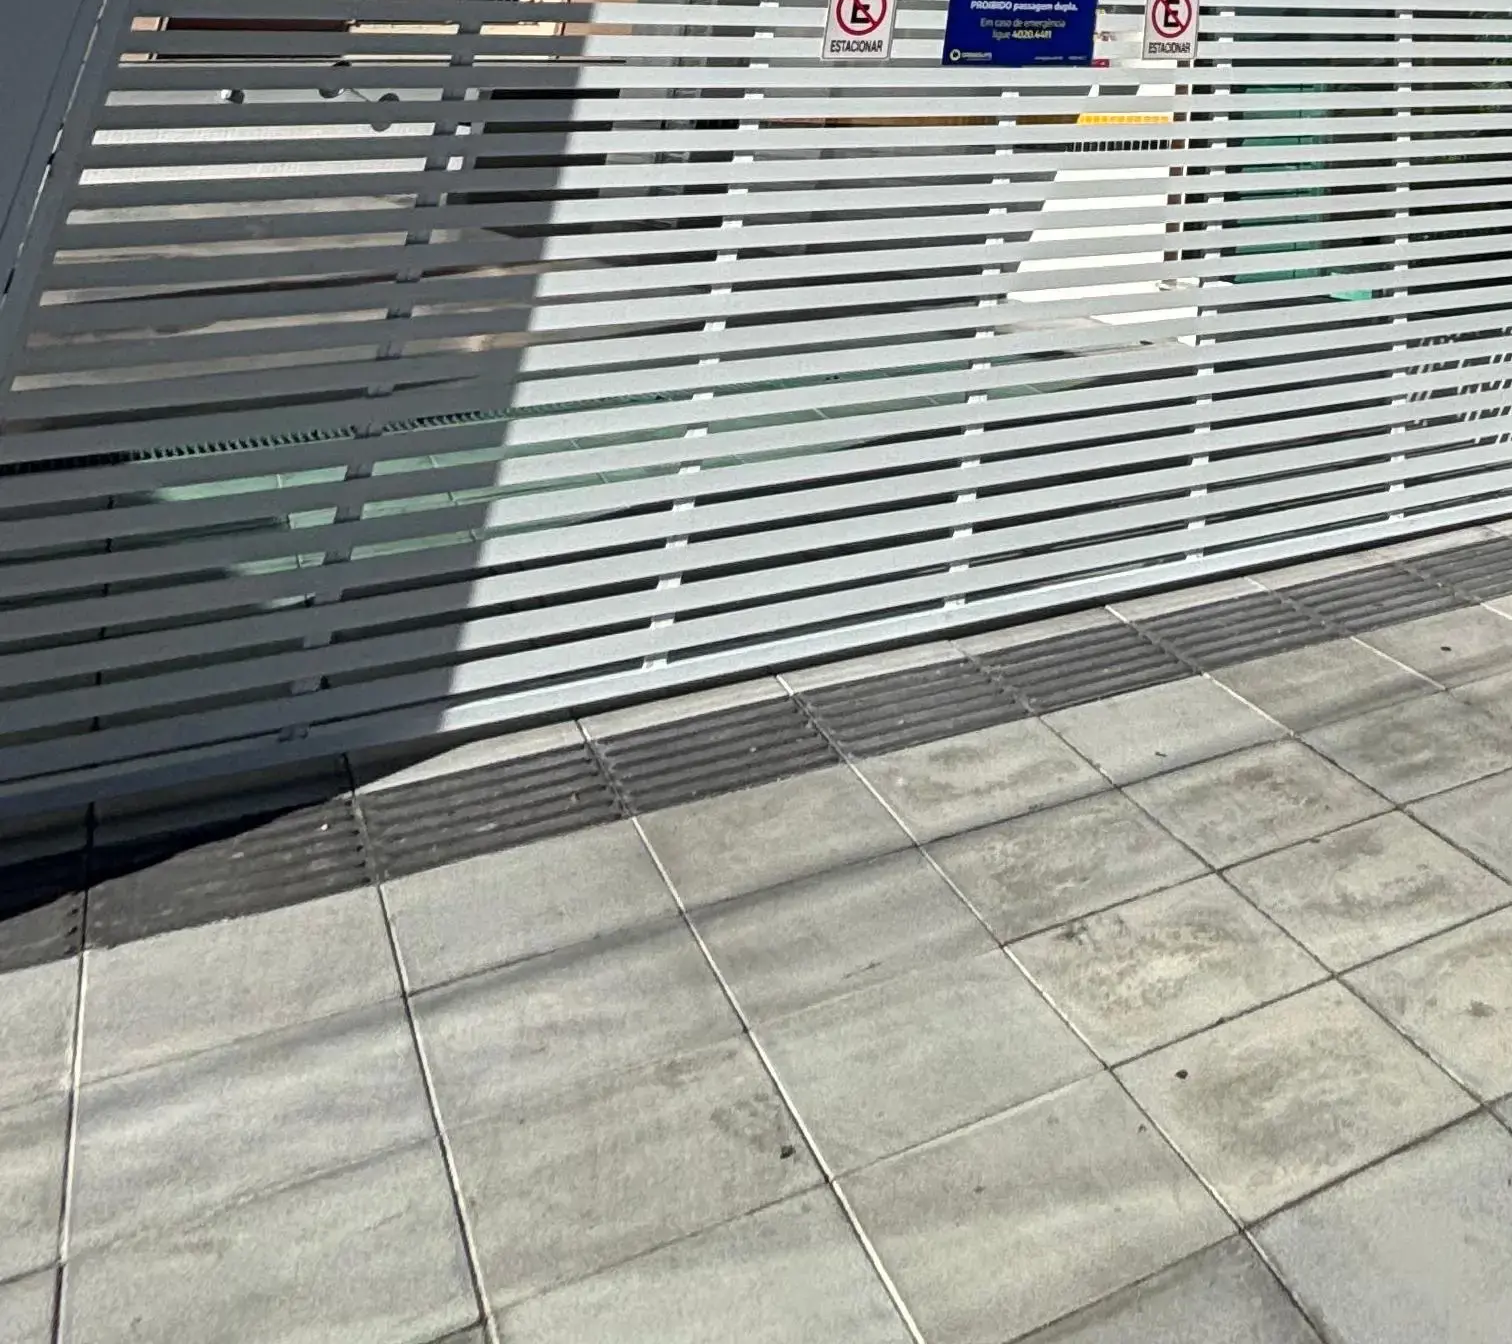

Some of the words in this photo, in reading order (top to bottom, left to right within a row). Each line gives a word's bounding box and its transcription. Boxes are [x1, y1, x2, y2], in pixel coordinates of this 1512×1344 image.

[970, 0, 1012, 10] PROIBIDO
[1013, 2, 1053, 13] passagem
[980, 17, 993, 28] Em
[994, 19, 1011, 28] caso
[1013, 17, 1023, 28] de
[829, 39, 884, 54] ESTACIONAR
[1148, 41, 1191, 55] ESTACIONAR
